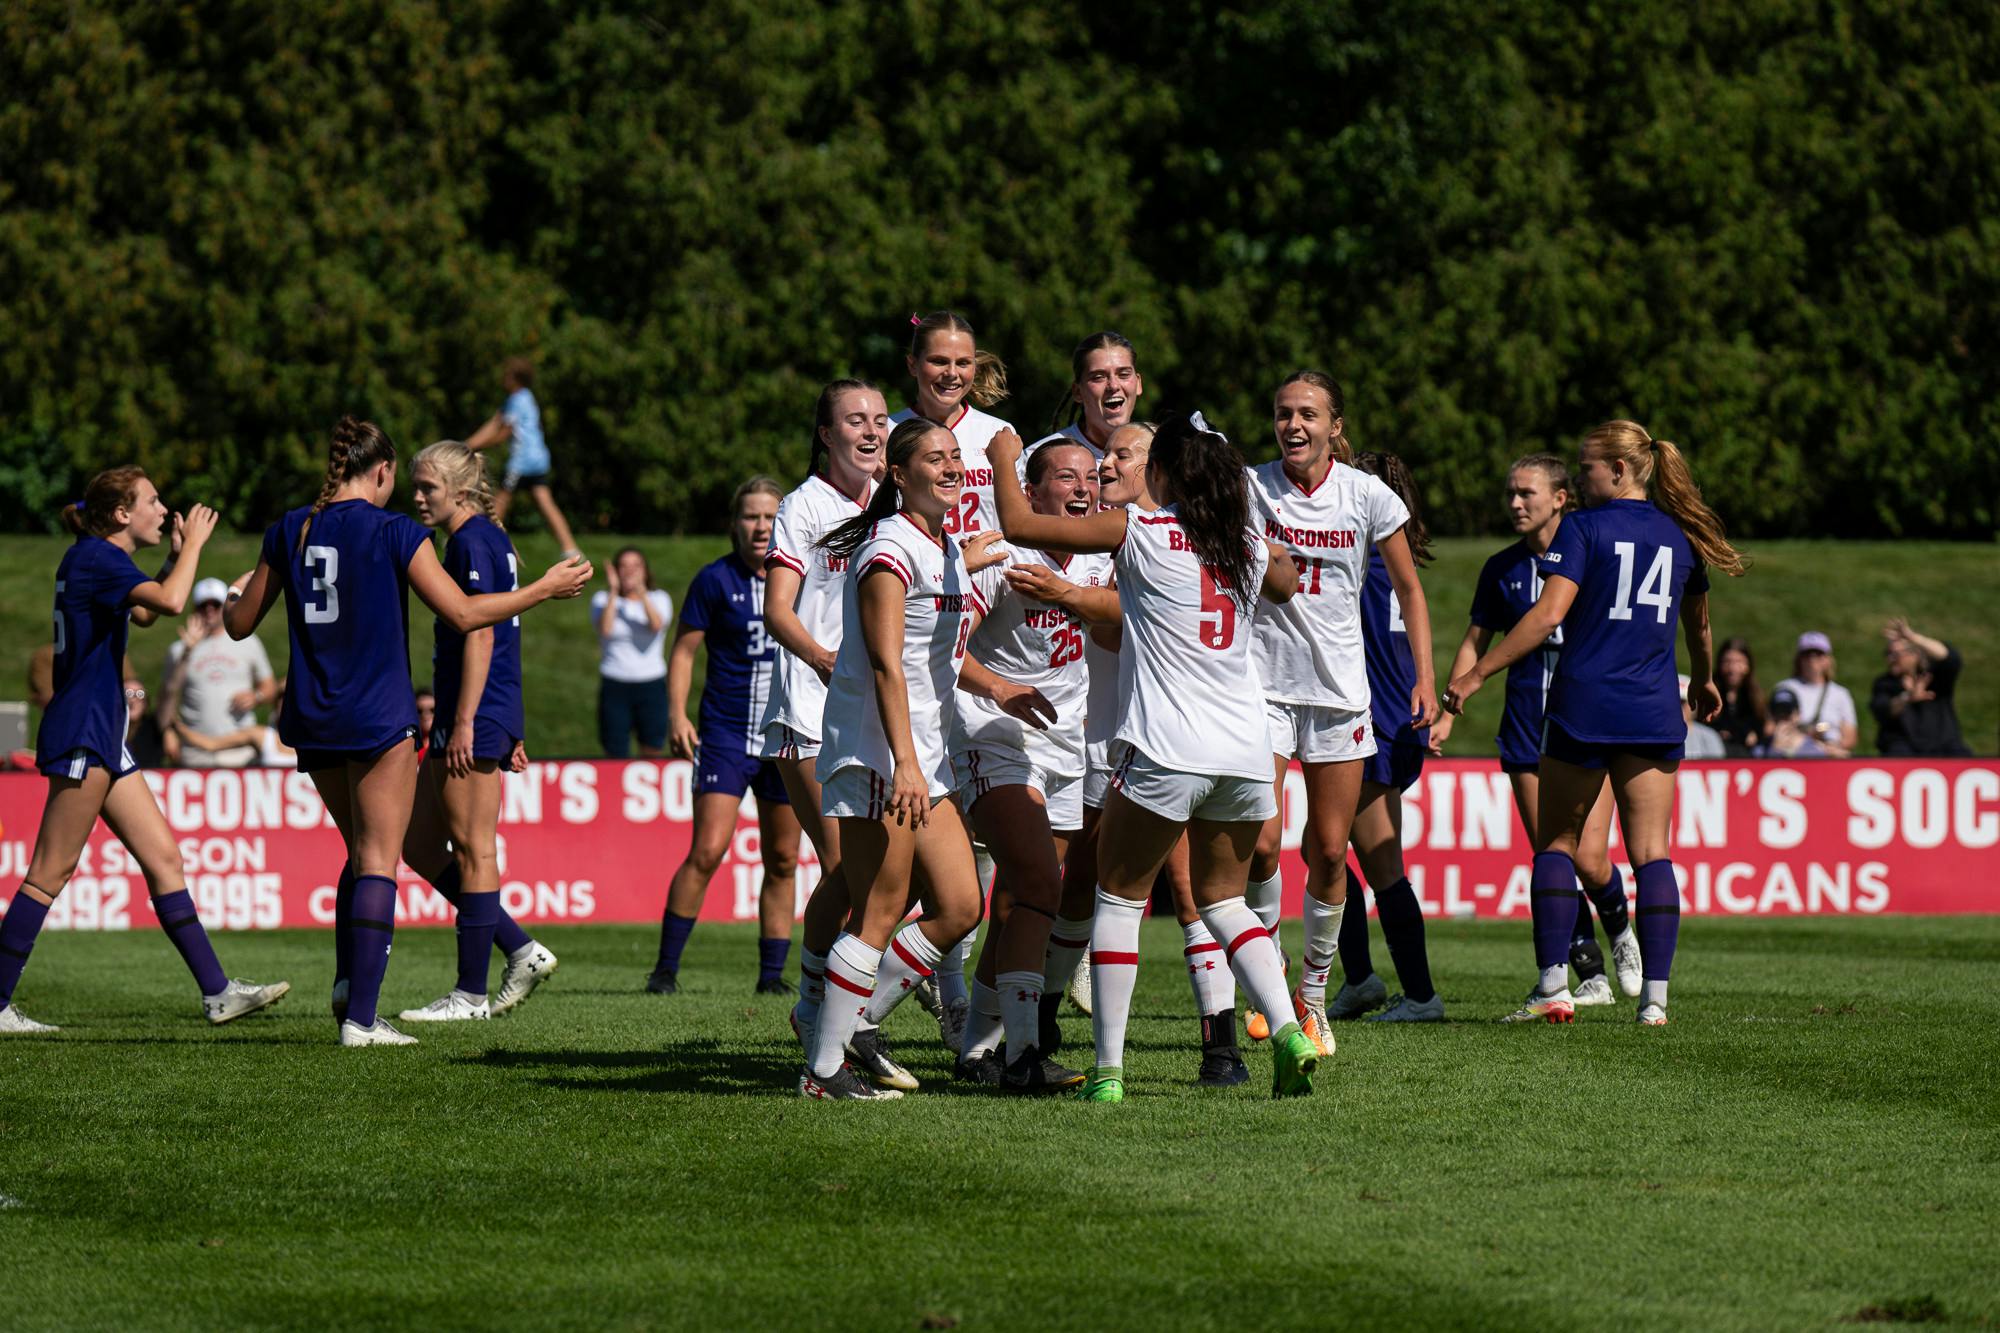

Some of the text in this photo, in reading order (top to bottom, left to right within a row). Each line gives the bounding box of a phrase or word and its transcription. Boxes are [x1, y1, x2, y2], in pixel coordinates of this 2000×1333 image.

[943, 492, 980, 534] 32
[1265, 519, 1356, 548] WISCONSIN
[304, 546, 339, 623] 3
[1199, 563, 1236, 650] 5
[1609, 541, 1673, 624] 14
[1049, 622, 1083, 668] 25
